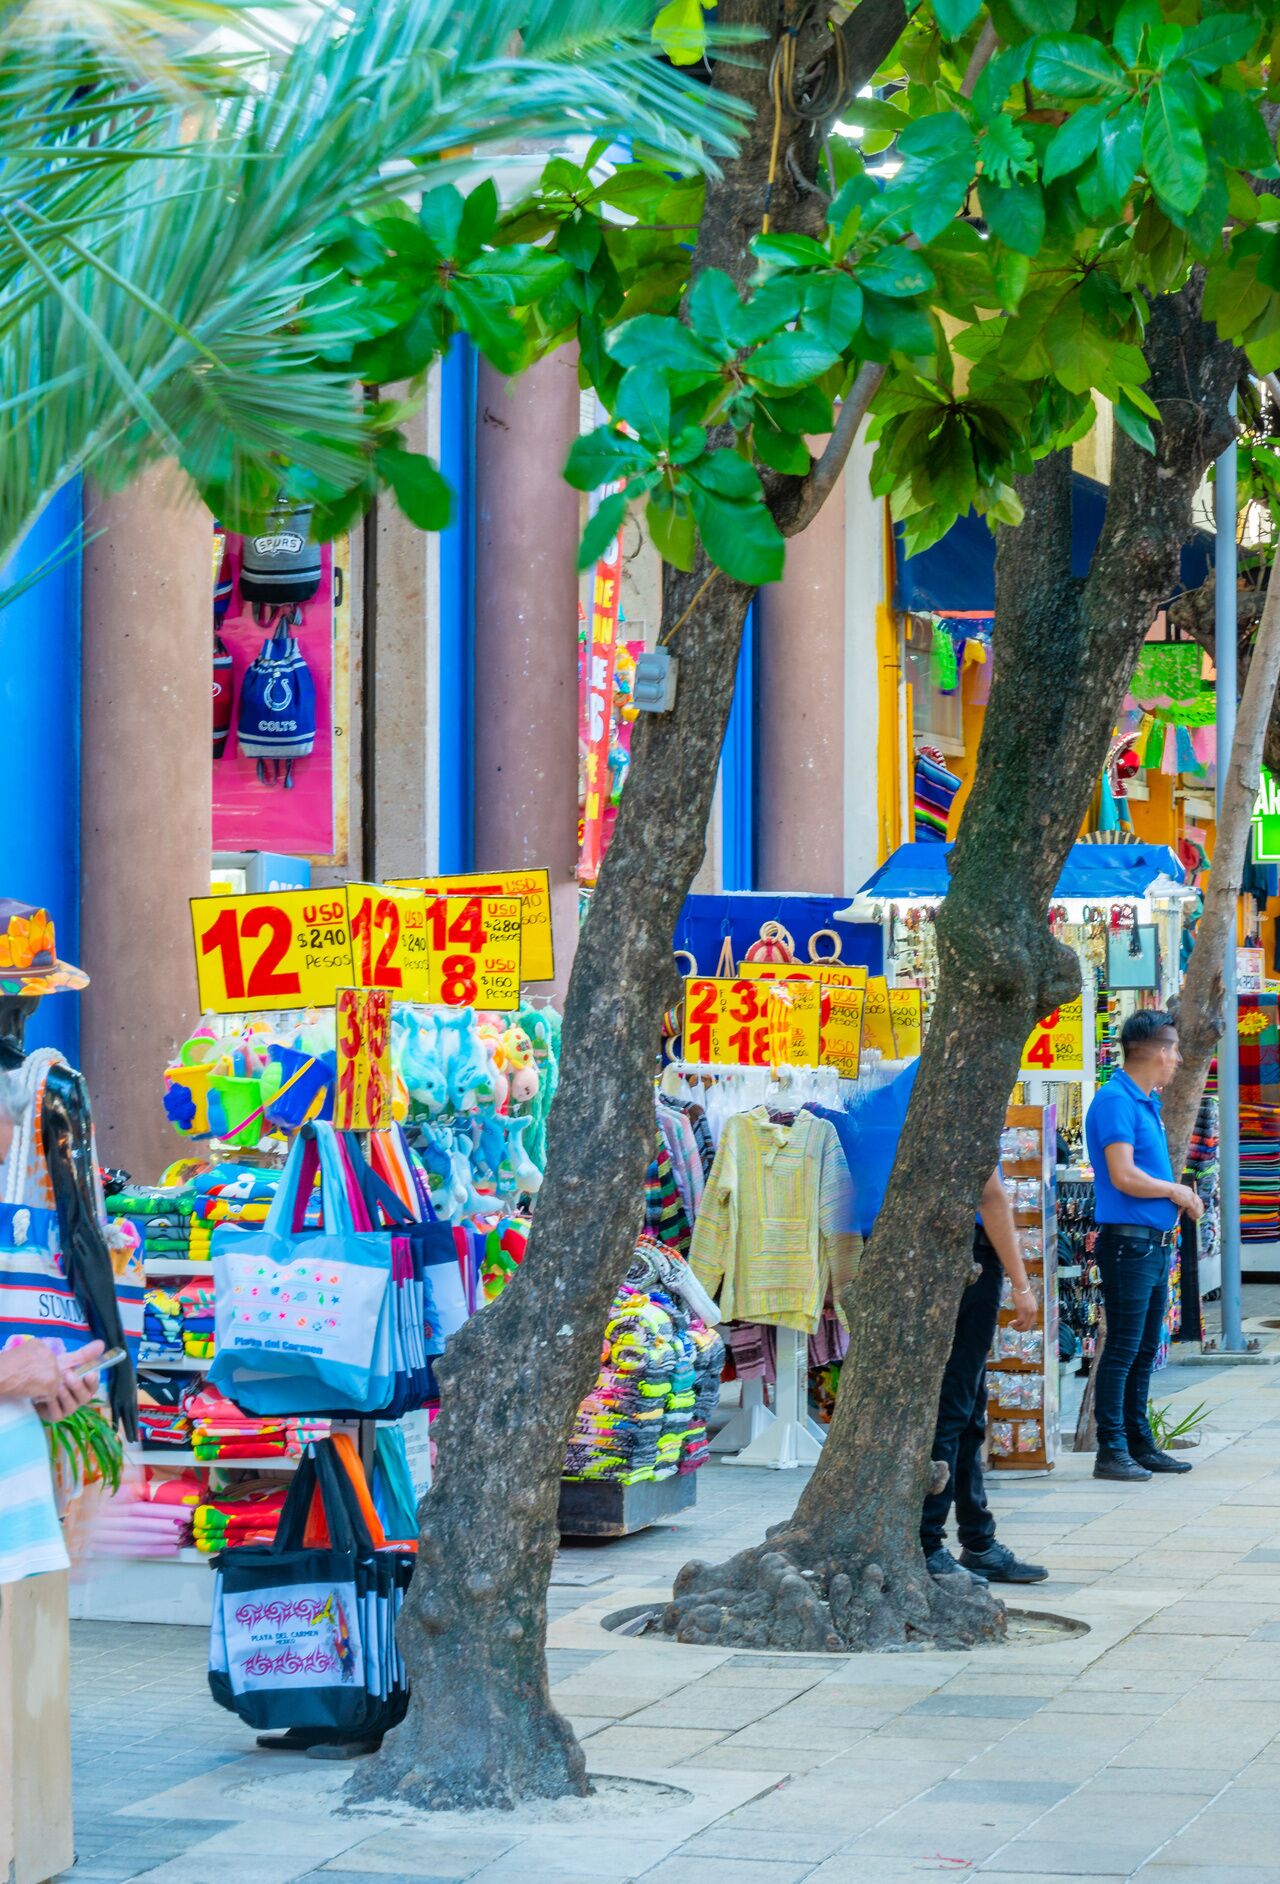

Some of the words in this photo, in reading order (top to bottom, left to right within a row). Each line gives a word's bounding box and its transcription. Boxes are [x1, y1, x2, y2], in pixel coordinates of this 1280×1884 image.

[258, 538, 297, 550] SPURS
[258, 720, 297, 731] COLTS
[521, 895, 542, 908] 40
[297, 929, 347, 950] $240
[351, 897, 403, 987] 12
[405, 911, 423, 925] USD
[425, 897, 487, 953] 14
[488, 903, 517, 915] USD
[484, 919, 520, 932] $280
[202, 905, 301, 999] 12
[303, 902, 344, 922] USD
[441, 954, 478, 1006] 8
[485, 959, 515, 970] USD
[689, 981, 718, 1024] 2
[689, 1024, 711, 1064] 1
[1027, 1034, 1054, 1069] 4
